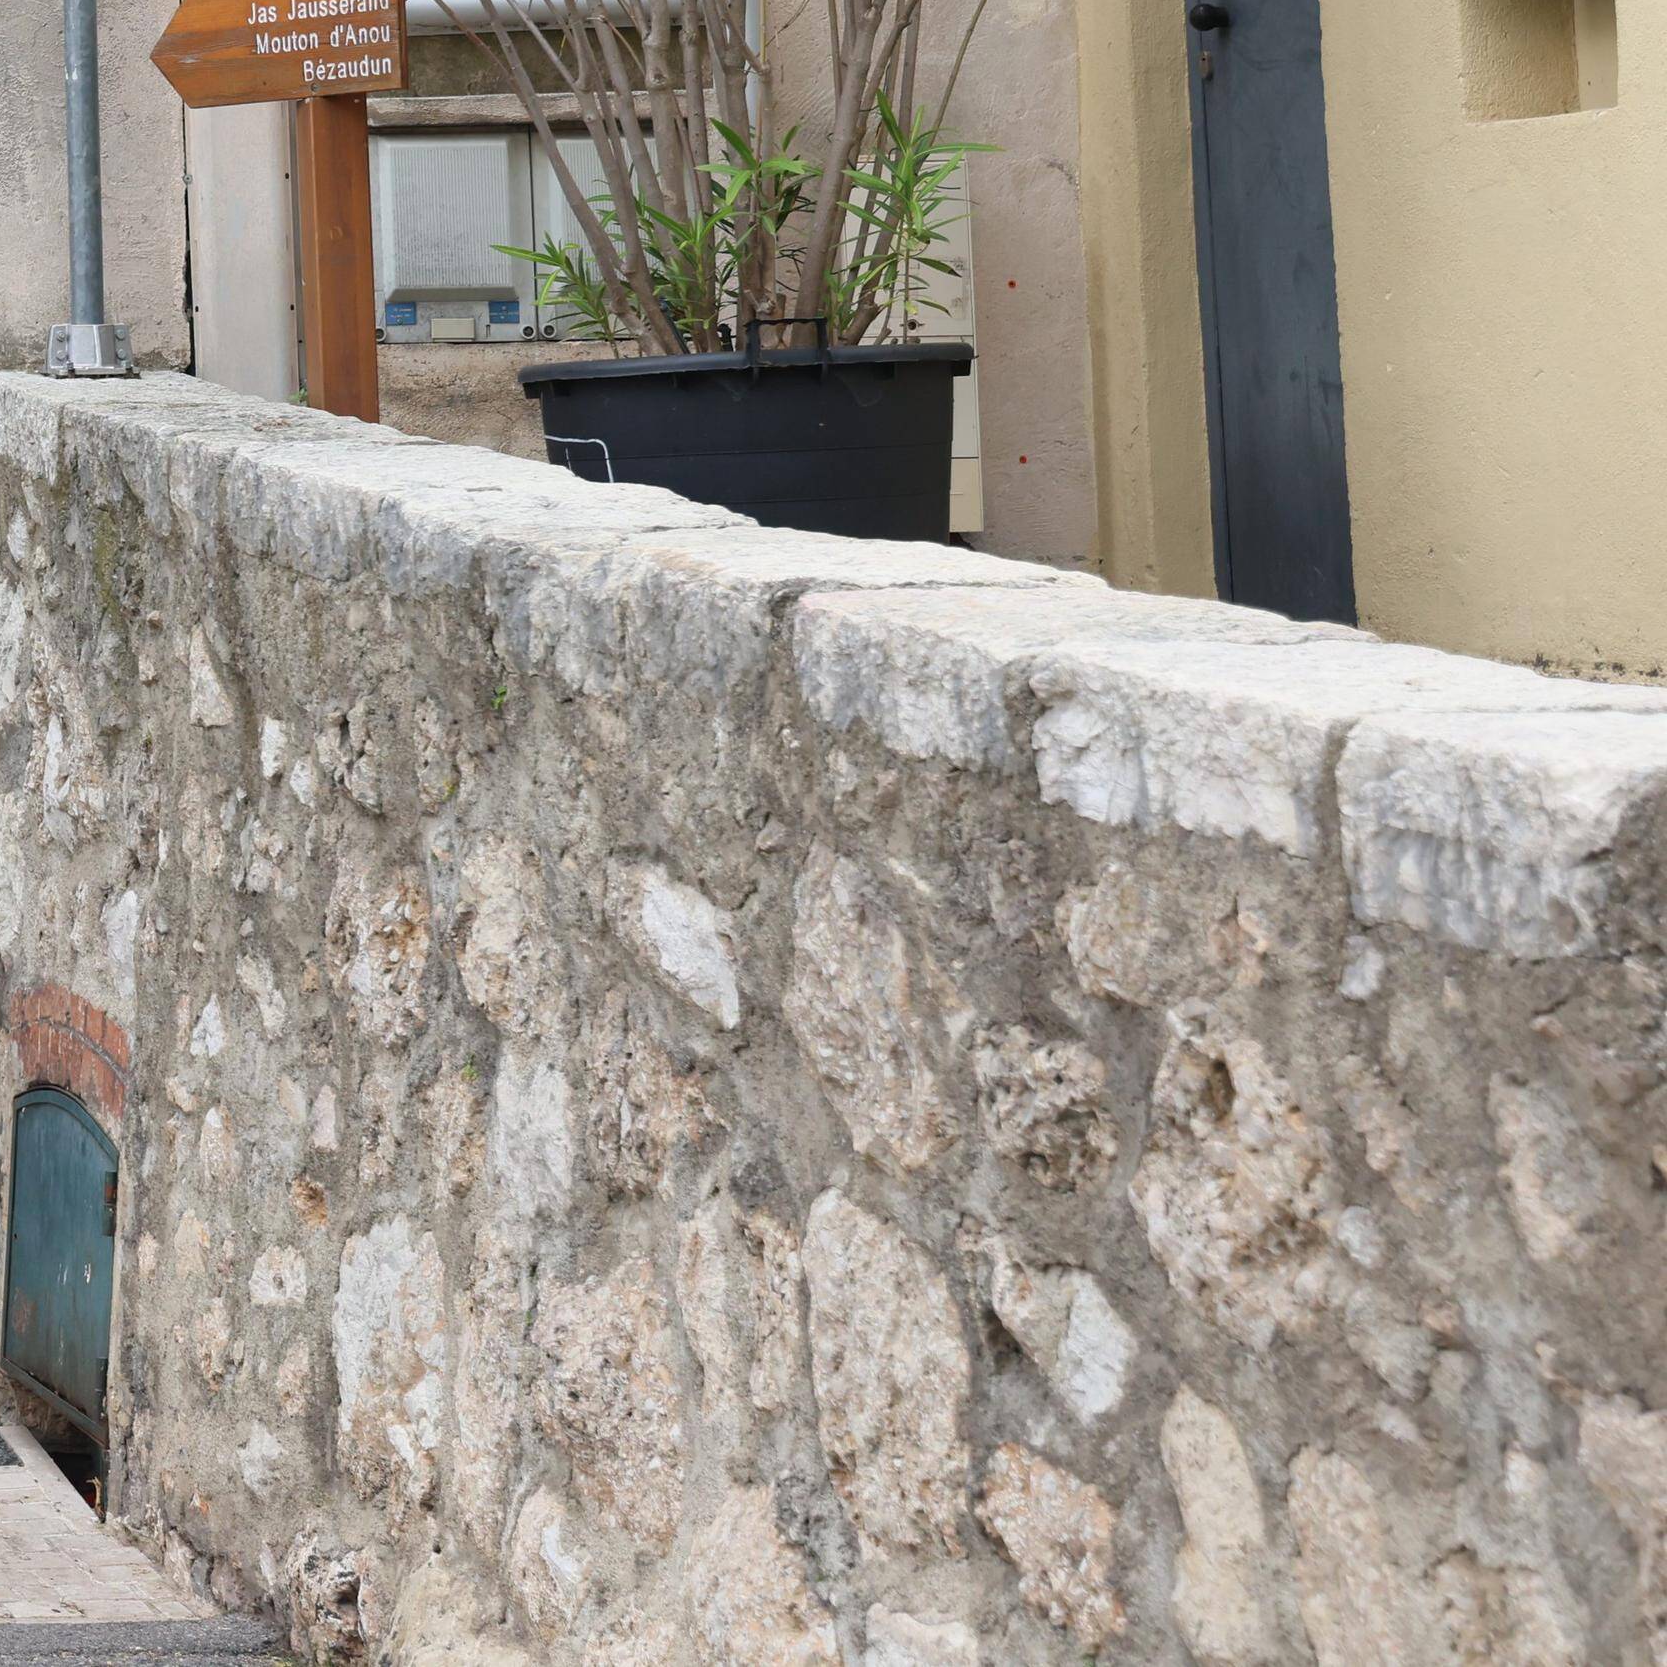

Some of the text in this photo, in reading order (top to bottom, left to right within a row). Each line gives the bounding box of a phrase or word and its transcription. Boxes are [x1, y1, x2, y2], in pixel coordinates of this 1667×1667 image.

[247, 2, 277, 25] Jas
[256, 23, 390, 54] Mouton d'Anou
[303, 54, 392, 82] Bézaudun
